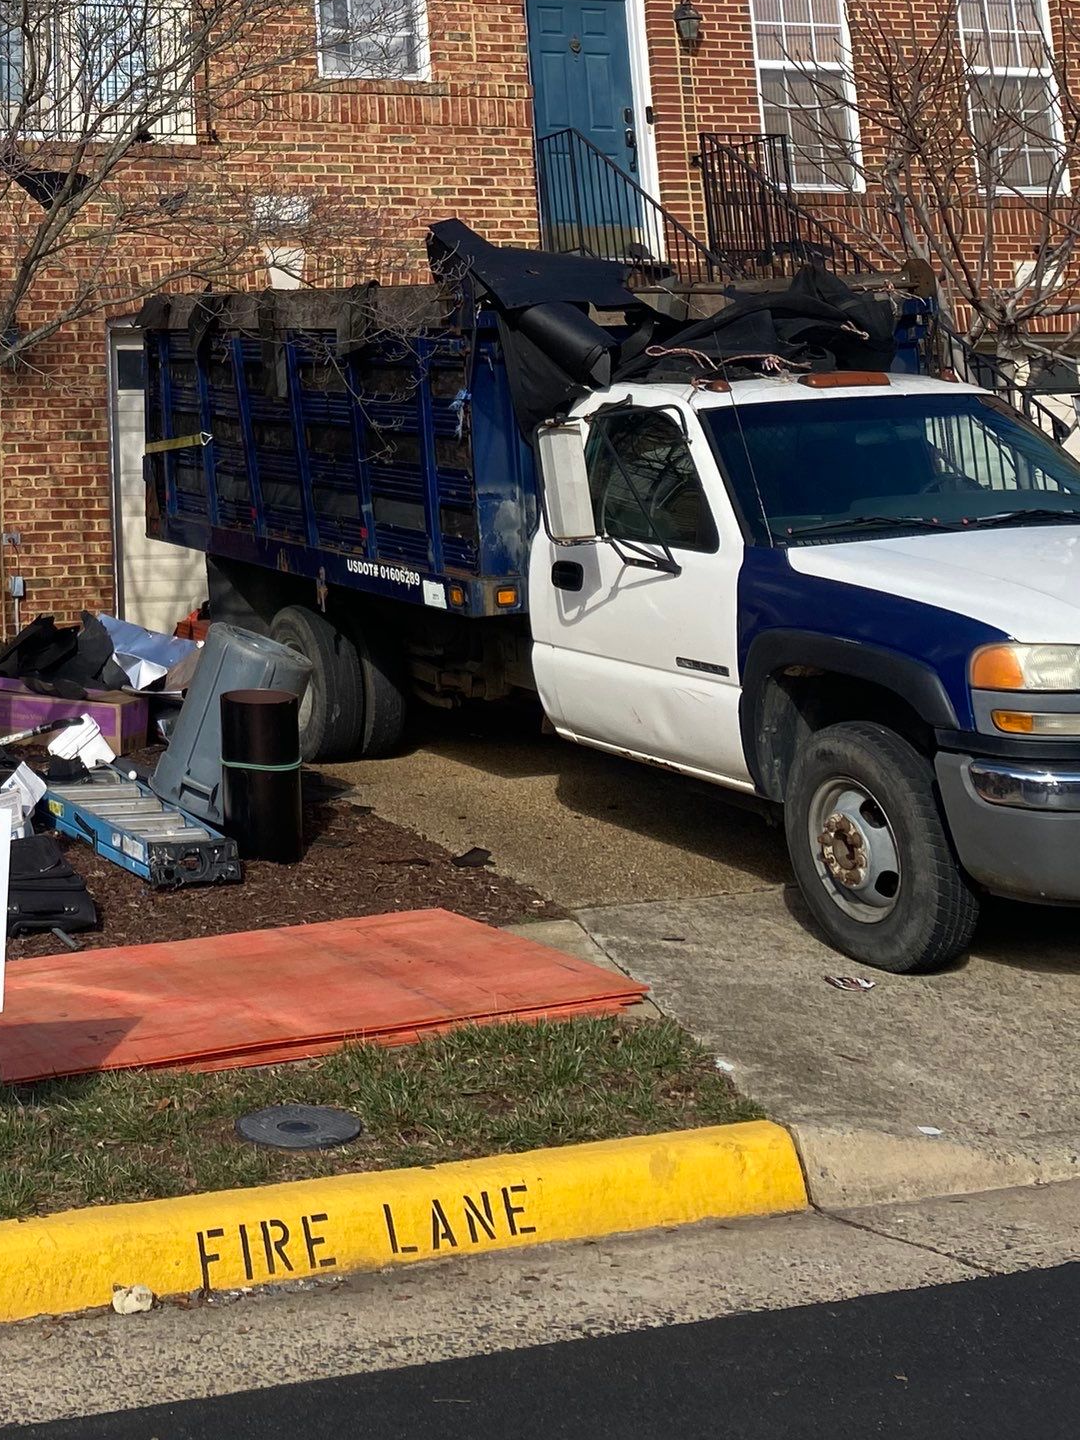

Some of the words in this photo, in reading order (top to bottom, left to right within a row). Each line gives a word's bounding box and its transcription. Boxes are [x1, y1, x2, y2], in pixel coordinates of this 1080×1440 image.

[346, 559, 379, 578] USDOT#
[380, 565, 421, 586] 01606289
[197, 1213, 337, 1292] FIRE
[383, 1184, 536, 1254] LANE
